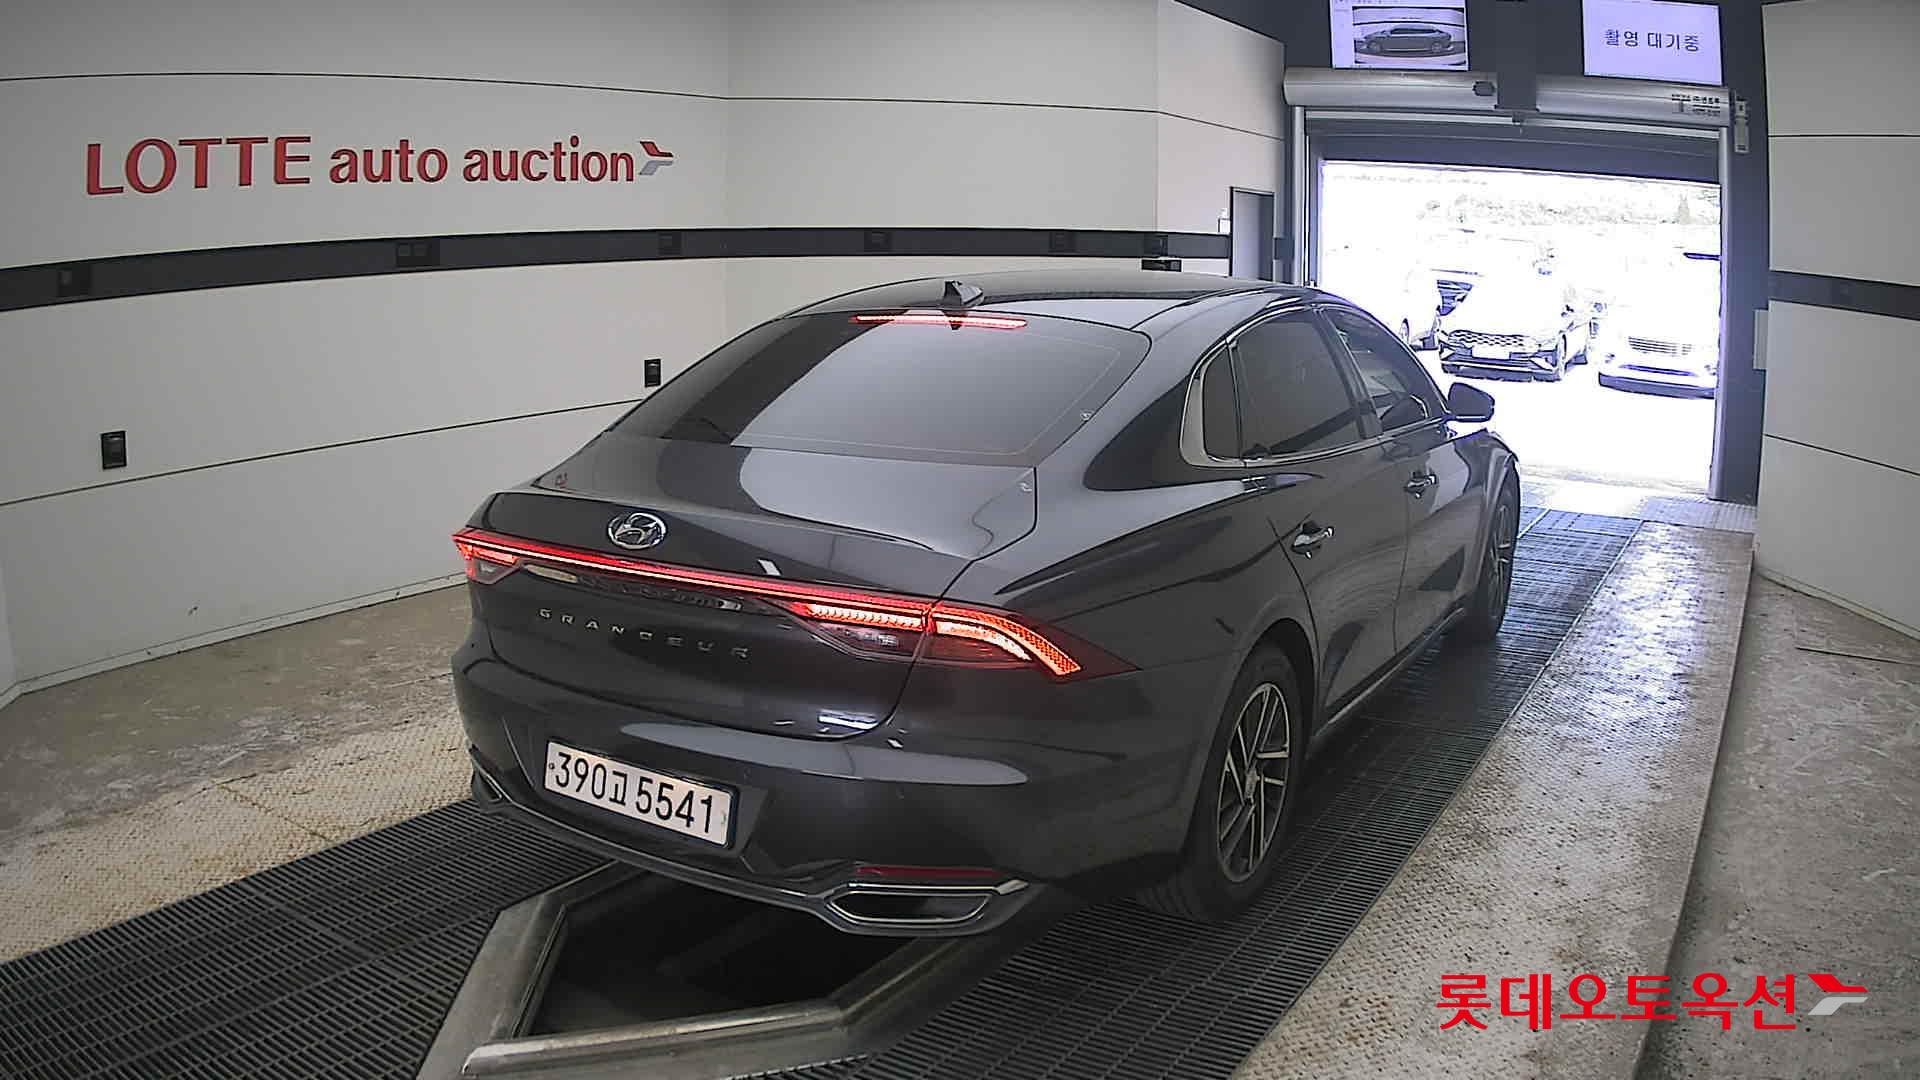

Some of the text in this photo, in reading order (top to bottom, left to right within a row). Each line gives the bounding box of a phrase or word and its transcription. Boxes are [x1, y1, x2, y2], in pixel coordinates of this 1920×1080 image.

[1647, 32, 1699, 52] 대기중
[86, 135, 634, 195] LOTTE auto auction
[537, 607, 750, 659] GRANDEUR
